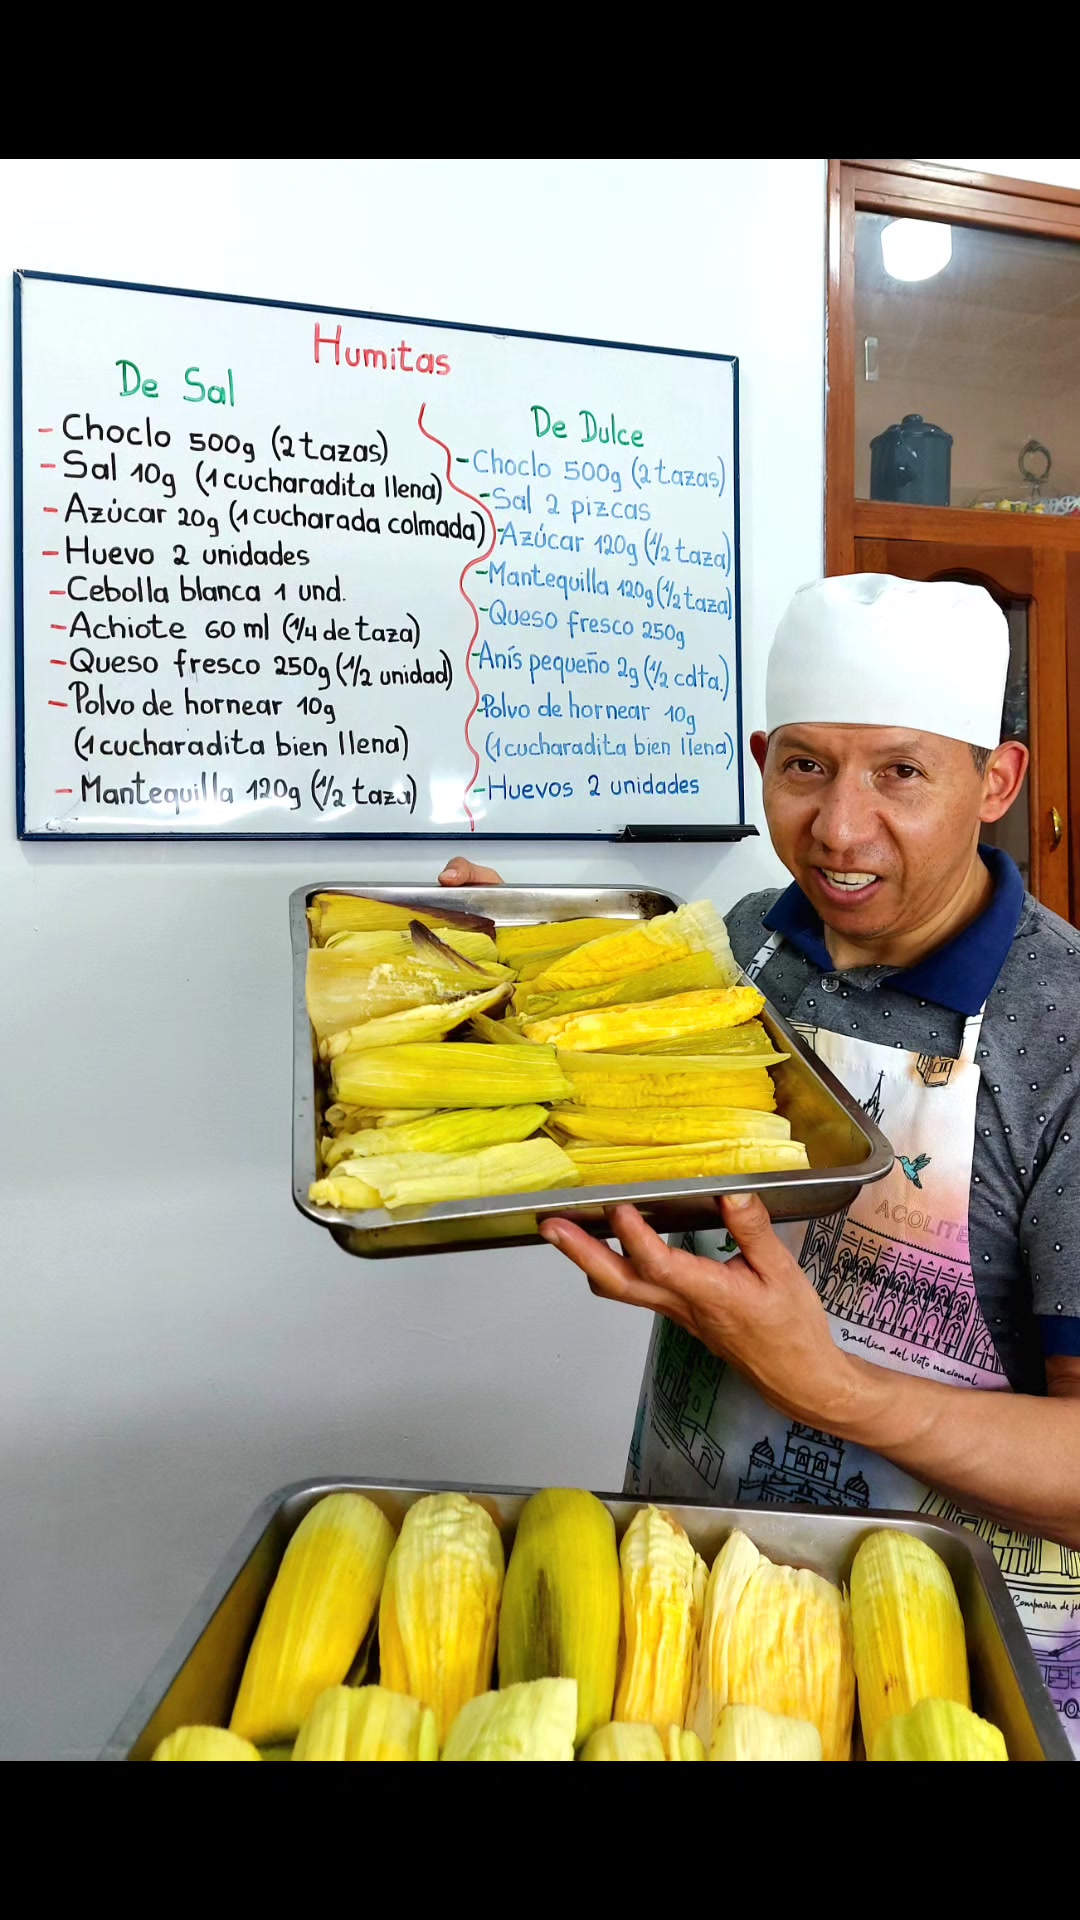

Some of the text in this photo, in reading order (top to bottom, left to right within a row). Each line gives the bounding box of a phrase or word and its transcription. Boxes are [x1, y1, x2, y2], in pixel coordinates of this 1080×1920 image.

[313, 321, 452, 376] Humitas
[115, 359, 235, 407] De Sal
[62, 412, 389, 466] Choclo 500g (2 tazas)
[530, 405, 645, 448] De Dulce
[62, 449, 117, 481] Sal
[130, 462, 177, 498] 10g
[223, 467, 376, 498] cucharadita
[384, 472, 443, 506] llena)
[473, 448, 726, 498] Choclo 500g (2 tazas)
[64, 491, 168, 524] Azúcar
[177, 507, 220, 538] 20g
[253, 503, 381, 534] cucharada
[387, 510, 486, 549] colmada)
[492, 485, 652, 524] Sal 2 pizcas
[66, 535, 311, 568] Huevo 2 unidades
[594, 533, 639, 567] 120g
[675, 531, 732, 578] taza)
[66, 575, 347, 604] Cebolla blanca 1 und.
[488, 560, 610, 600] Mantequilla
[617, 578, 655, 609] 120g
[683, 585, 733, 621] taza)
[69, 611, 188, 640] Achiote
[204, 620, 237, 639] 60
[243, 612, 269, 640] ml
[323, 618, 351, 641] de
[355, 612, 421, 649] taza)
[488, 598, 686, 651] Queso fresco 250g
[69, 647, 159, 676] Queso
[172, 648, 261, 678] fresco
[273, 654, 332, 691] 250g
[379, 648, 454, 692] unidad)
[529, 651, 611, 685] pequeño
[617, 656, 640, 689] 2g
[673, 653, 730, 702] cdta.)
[68, 680, 337, 725] Polvo de hornear 10g
[481, 690, 697, 736] Polvo de hornear 10g
[99, 728, 266, 758] cucharadita
[275, 730, 329, 757] bien
[338, 724, 409, 761] llena)
[503, 731, 627, 757] cucharadita
[633, 733, 671, 756] bien
[680, 731, 735, 770] llena)
[81, 770, 235, 815] Mantequilla
[246, 776, 302, 811] 120g
[351, 773, 418, 815] taza)
[488, 772, 700, 801] Huevos 2 unidades
[889, 1347, 909, 1362] del
[911, 1353, 930, 1370] Voto
[932, 1363, 979, 1387] nacional
[1060, 1600, 1070, 1611] de
